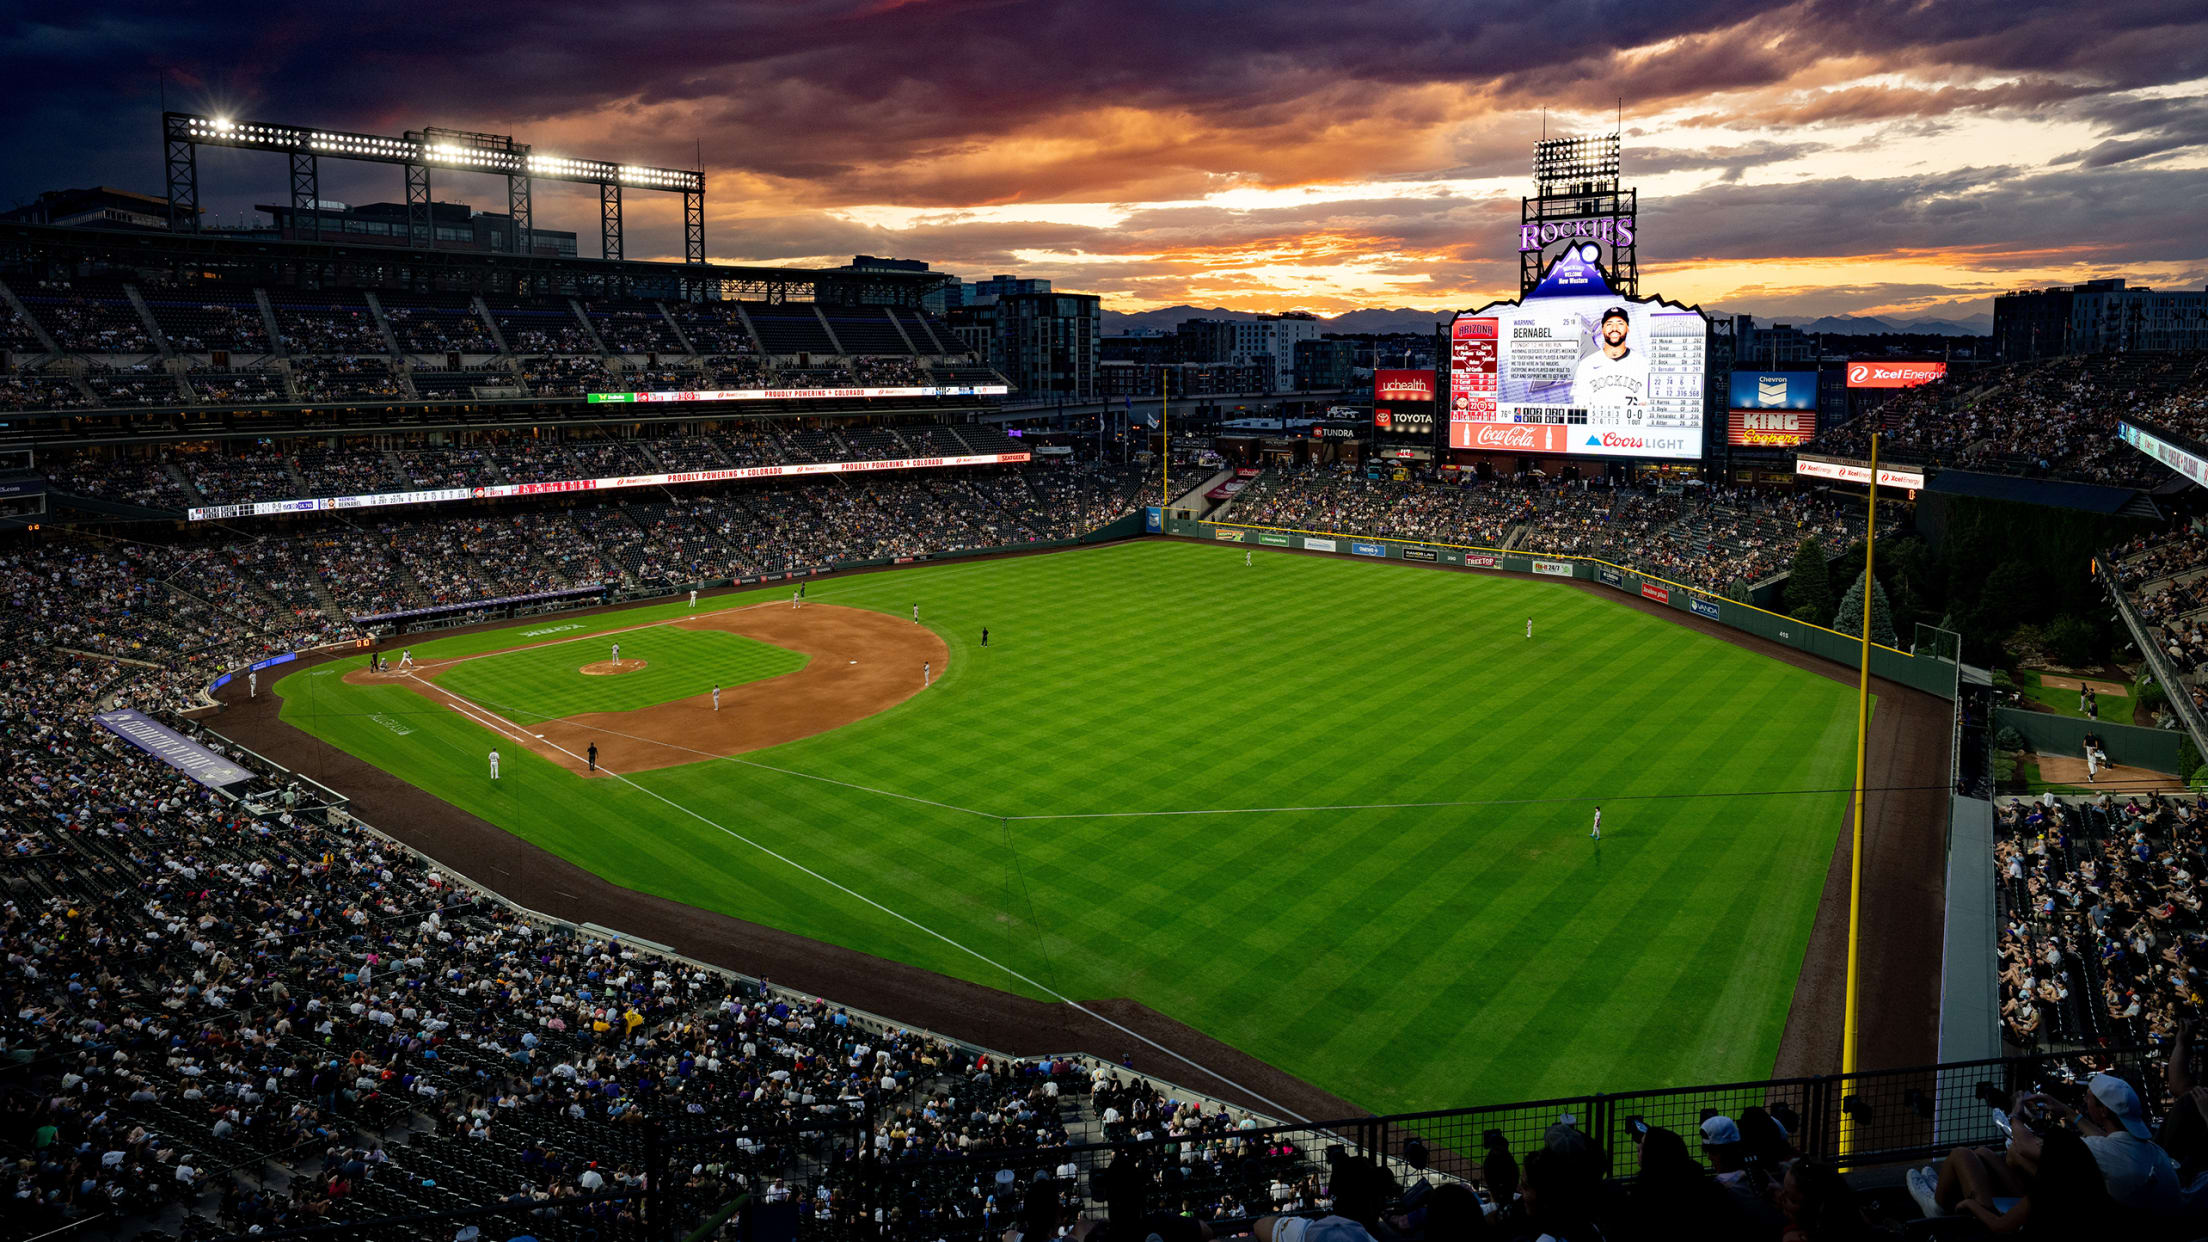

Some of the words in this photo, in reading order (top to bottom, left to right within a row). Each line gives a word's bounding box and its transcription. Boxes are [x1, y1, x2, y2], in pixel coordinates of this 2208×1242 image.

[1518, 217, 1634, 252] ROCKIES
[1458, 324, 1493, 336] ARIZONA
[1513, 328, 1552, 338] BERNABEL
[1873, 369, 1902, 379] Xcel
[1382, 378, 1426, 391] uchealth
[1590, 375, 1642, 393] ROCKIES
[765, 390, 792, 398] PROUDLY
[1393, 413, 1433, 423] TOYOTA
[1743, 414, 1799, 430] KING
[1322, 428, 1354, 437] TUNDRA
[1743, 429, 1799, 446] Soopers
[1602, 432, 1643, 449] Coors
[1645, 437, 1684, 450] LIGHT
[841, 463, 869, 471] PROUDLY
[872, 461, 904, 469] POWERING
[913, 458, 943, 466] COLORADO
[1001, 454, 1025, 462] SEATGEEK
[667, 473, 700, 482] PROUDLY
[702, 470, 738, 481] POWERING
[747, 467, 783, 477] COLORADO
